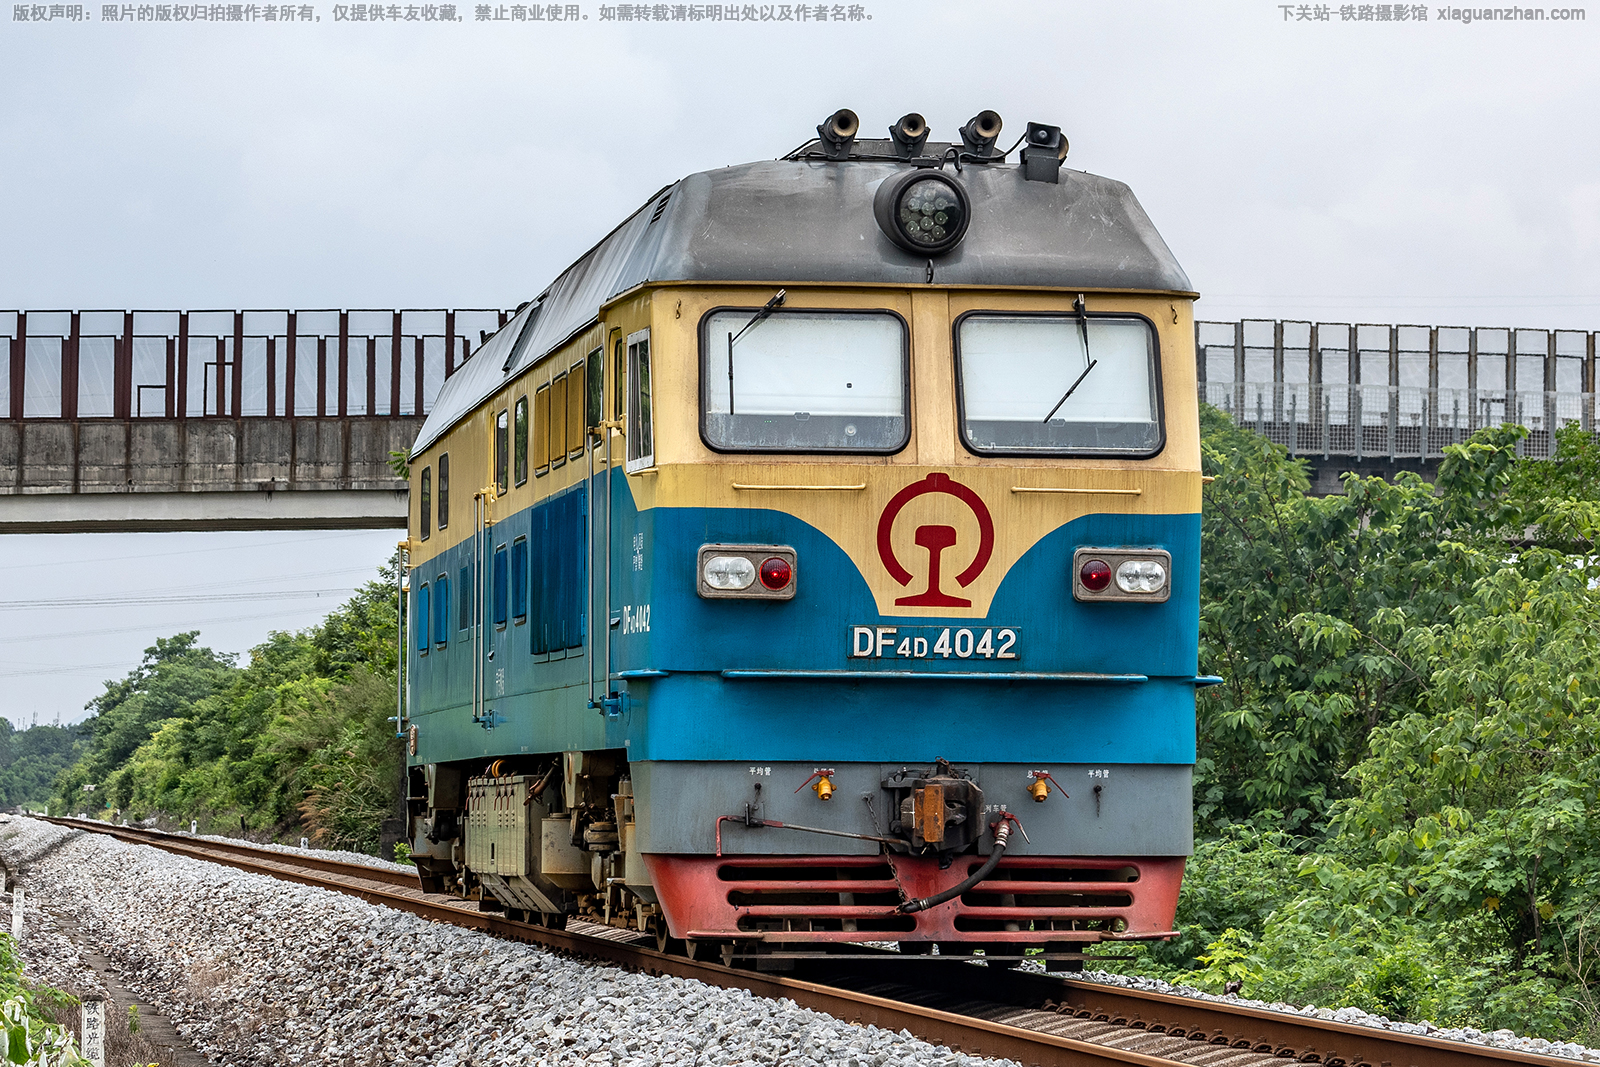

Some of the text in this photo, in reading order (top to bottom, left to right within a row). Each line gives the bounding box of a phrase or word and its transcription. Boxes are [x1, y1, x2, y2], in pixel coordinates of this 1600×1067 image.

[749, 766, 772, 776] 平均管
[1088, 769, 1110, 779] 平均管
